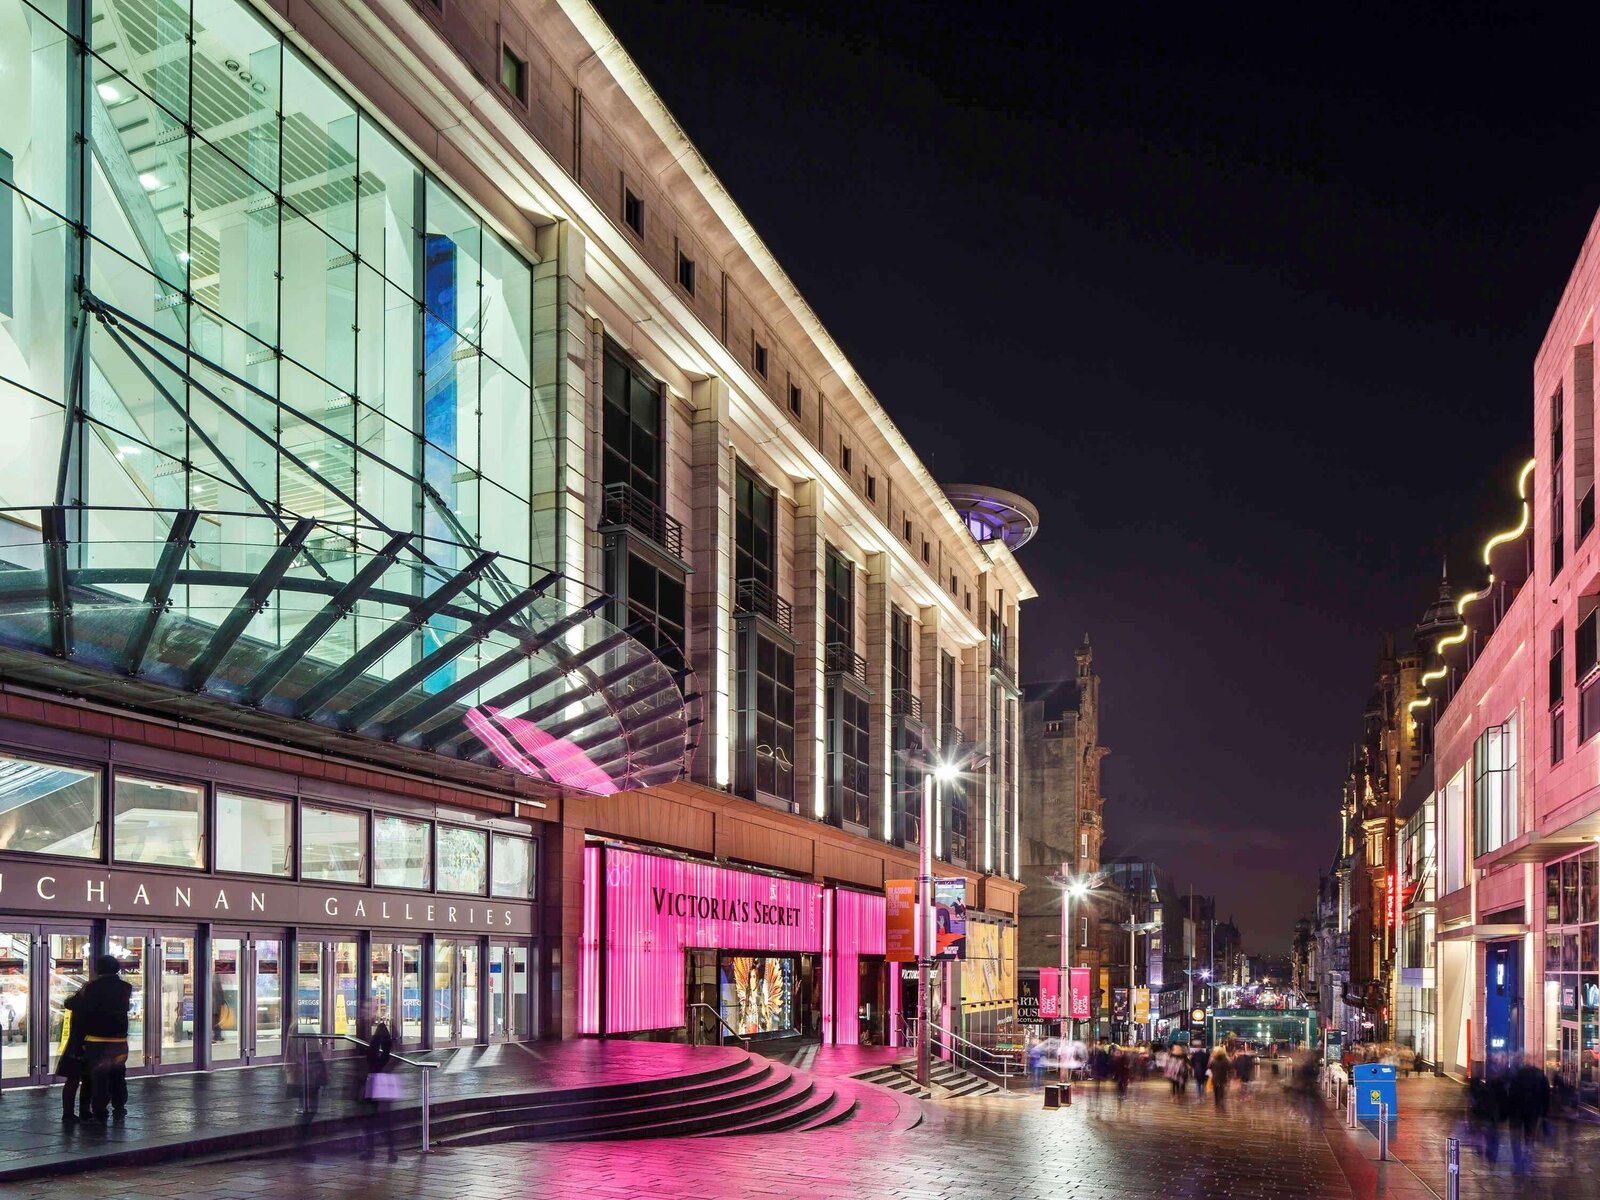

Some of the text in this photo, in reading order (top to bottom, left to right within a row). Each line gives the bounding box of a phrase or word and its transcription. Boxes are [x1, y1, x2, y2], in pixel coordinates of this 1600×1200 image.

[0, 874, 512, 926] CHANAN GALLERIES
[652, 886, 801, 927] VICTORIA'S SECRET
